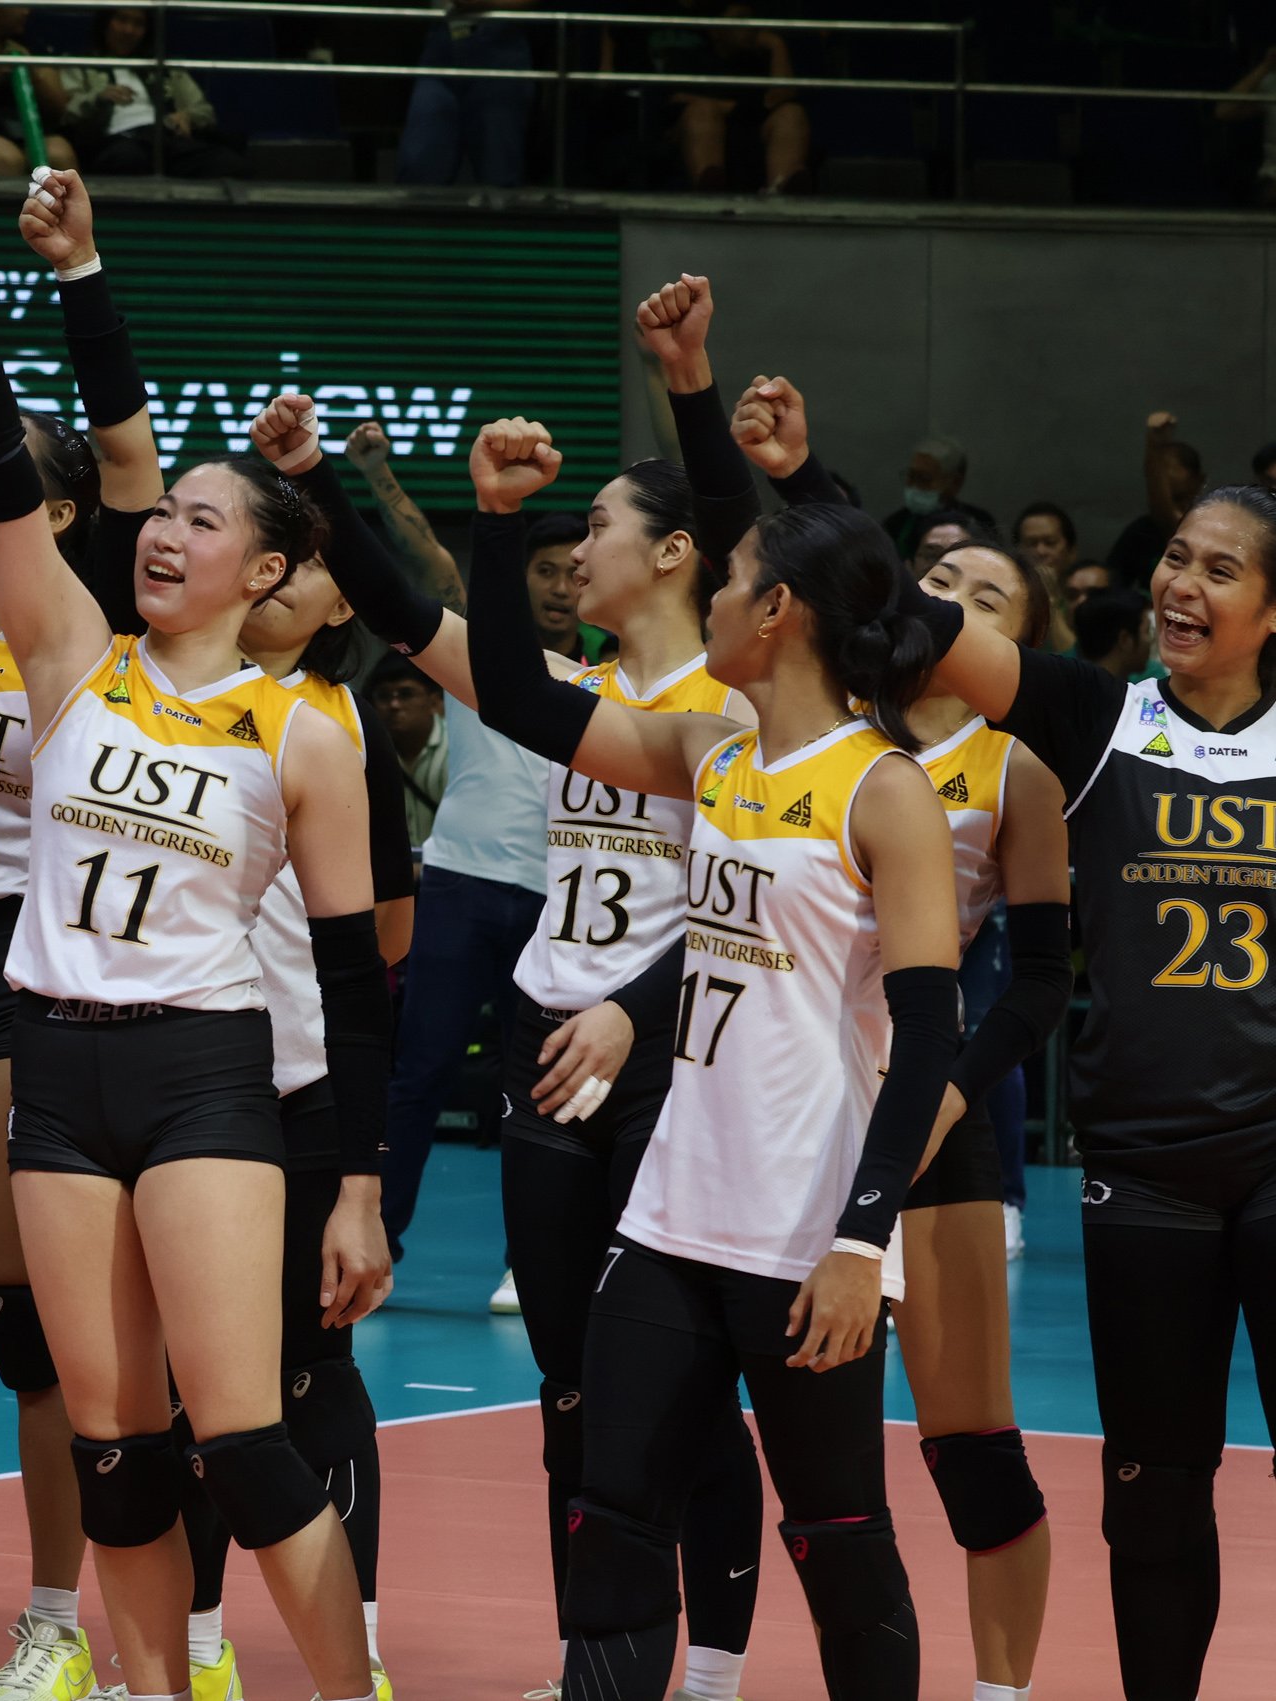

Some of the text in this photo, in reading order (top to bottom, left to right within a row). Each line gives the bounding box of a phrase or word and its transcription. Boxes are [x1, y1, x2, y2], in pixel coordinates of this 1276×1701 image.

[4, 349, 472, 470] Syview
[164, 707, 203, 727] DATEM
[226, 728, 260, 744] DELTA
[1209, 747, 1248, 757] DATEM
[88, 740, 229, 822] UST
[937, 788, 969, 805] DELTA
[50, 802, 234, 870] GOLDEN TIGRESSES
[780, 813, 812, 829] DELTA
[597, 834, 683, 860] TIGRESSES
[64, 848, 162, 948] 11
[687, 849, 776, 927] UST
[1122, 862, 1276, 889] GOLDEN TIGRE
[549, 863, 633, 946] 13
[711, 937, 796, 972] TIGRESSES
[1151, 897, 1271, 991] 23
[673, 969, 747, 1068] 17
